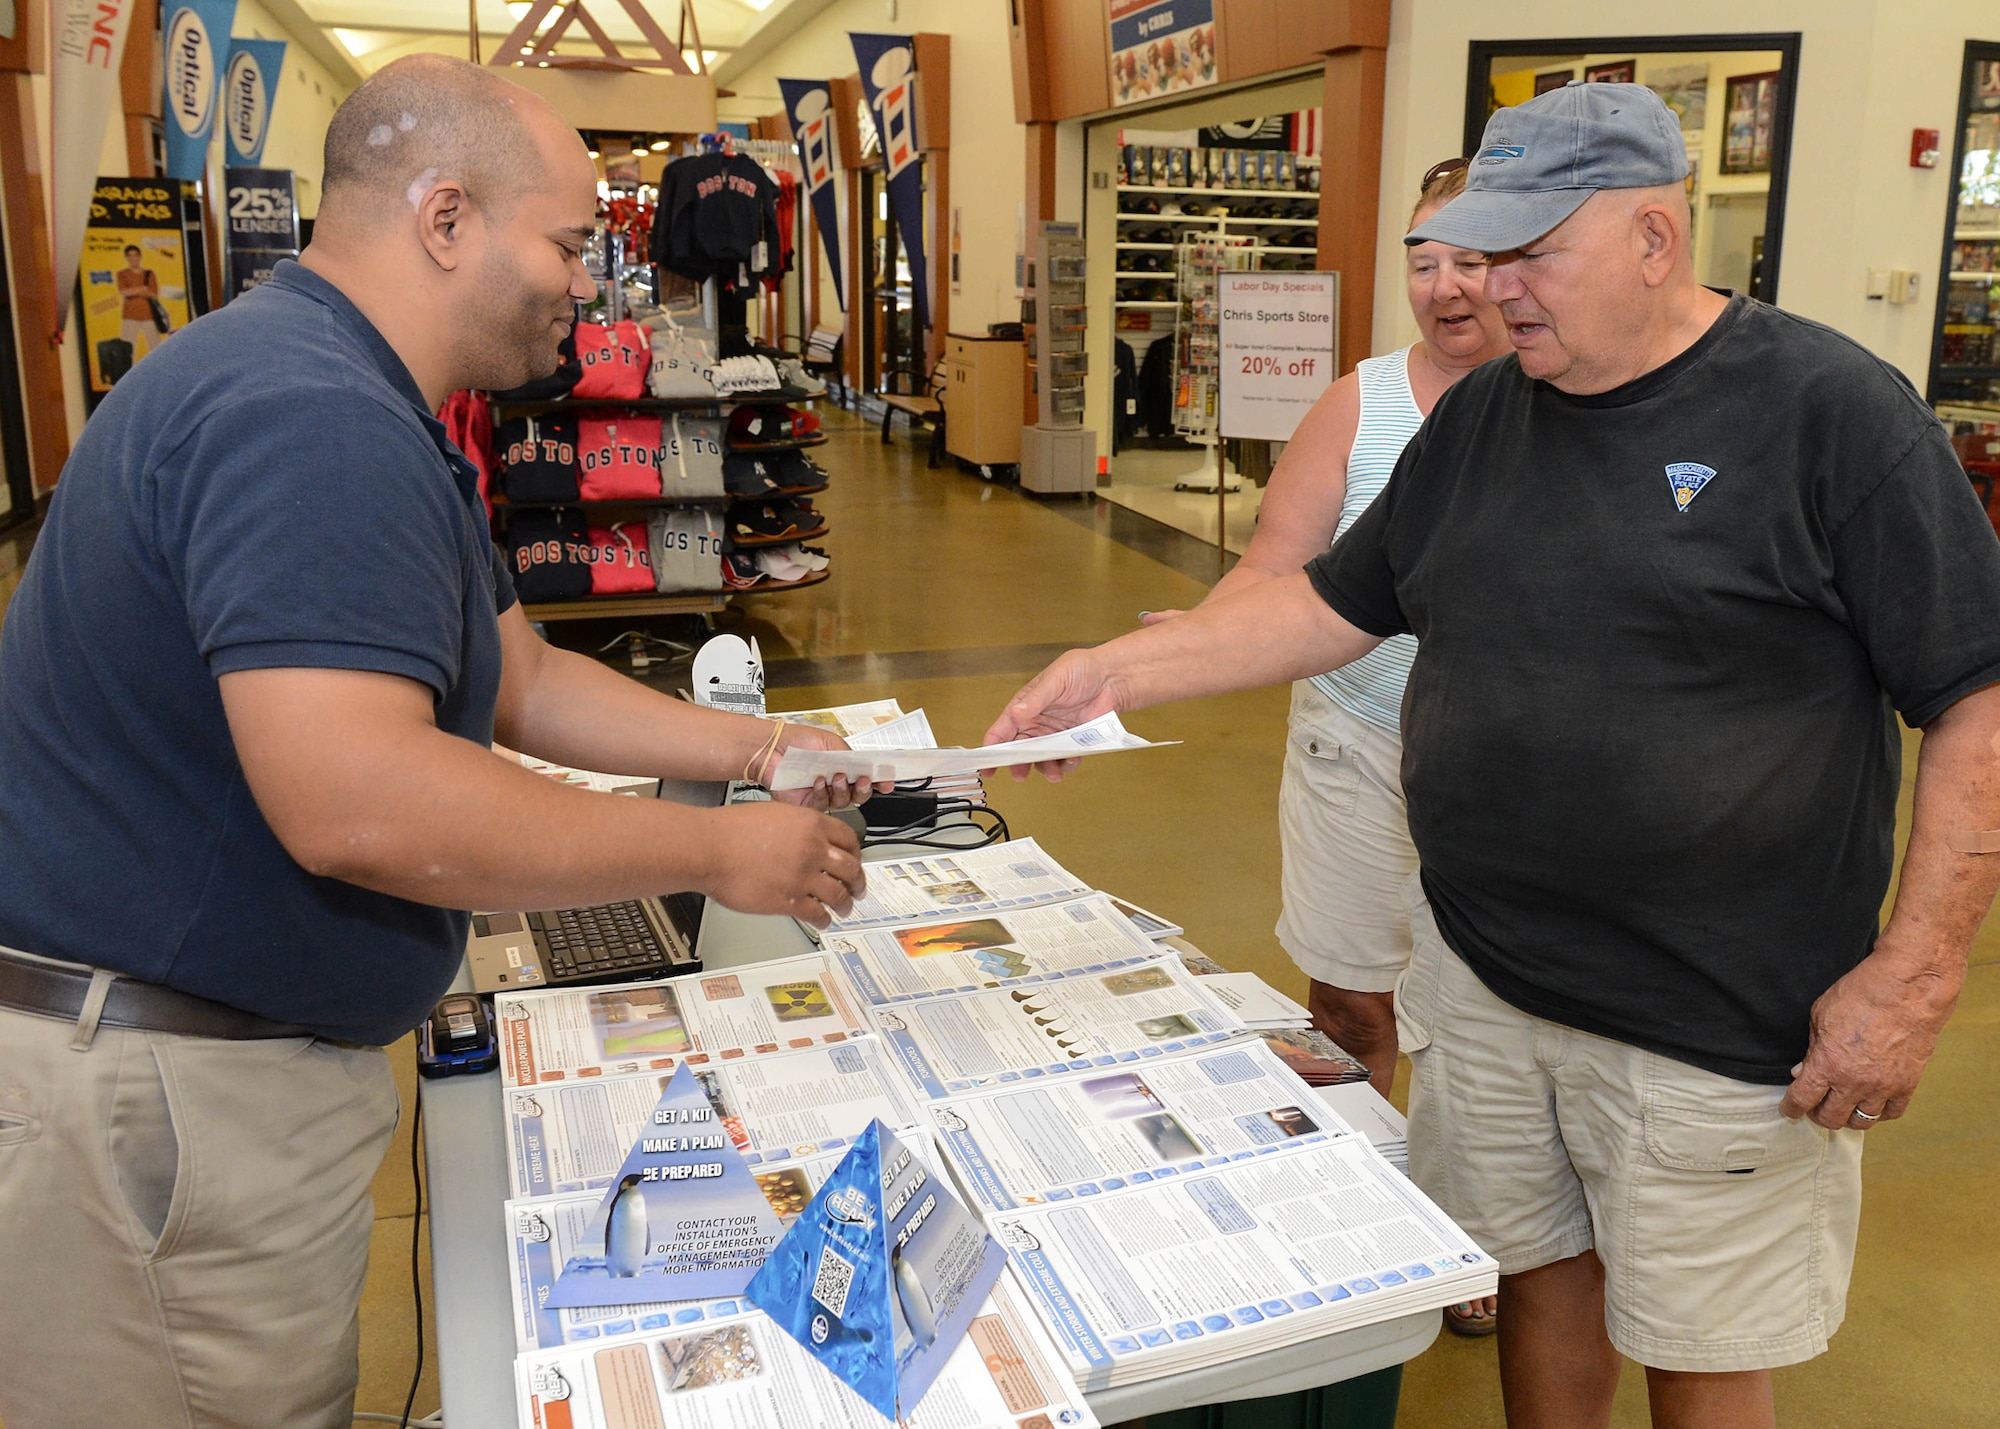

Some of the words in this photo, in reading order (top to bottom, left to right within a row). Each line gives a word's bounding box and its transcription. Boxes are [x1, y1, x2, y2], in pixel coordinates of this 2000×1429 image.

[1148, 11, 1174, 31] CHRIS
[86, 0, 122, 68] NC
[181, 28, 201, 118] Optical
[239, 68, 256, 142] Optical
[697, 174, 757, 199] BOSTON
[118, 203, 172, 220] TAGS
[229, 187, 290, 218] 25%
[233, 219, 291, 233] LENSES
[1232, 282, 1259, 291] Labor
[1262, 282, 1279, 293] Day
[1283, 282, 1324, 292] Specials
[1223, 309, 1253, 320] Chris
[1257, 310, 1294, 323] Sports
[1298, 311, 1329, 322] Store
[1242, 356, 1282, 376] 20%
[1288, 358, 1315, 376] off
[1666, 464, 1714, 478] MASSACHUSETTS
[1675, 474, 1702, 483] STATE
[1674, 481, 1699, 489] POLICE
[515, 1020, 525, 1039] PLANTS
[517, 1040, 528, 1059] POWER
[520, 1060, 531, 1082] NUCLEAR
[905, 1045, 930, 1078] TORNADOES
[655, 1110, 676, 1124] GET
[681, 1109, 689, 1122] A
[692, 1107, 712, 1121] KIT
[528, 1135, 540, 1150] HEAT
[642, 1137, 677, 1153] MAKE
[681, 1137, 689, 1150] A
[692, 1135, 724, 1150] PLAN
[955, 1130, 977, 1156] LIGHTNING
[530, 1152, 544, 1182] EXTREME
[881, 1167, 896, 1189] GET
[892, 1160, 902, 1175] A
[897, 1148, 911, 1168] KIT
[970, 1156, 984, 1166] AND
[643, 1167, 659, 1181] BE
[661, 1163, 723, 1180] PREPARED
[846, 1185, 867, 1207] BE
[886, 1192, 907, 1222] MAKE
[903, 1186, 912, 1200] A
[908, 1167, 926, 1194] PLAN
[677, 1218, 726, 1230] CONTACT
[728, 1216, 757, 1226] YOUR
[832, 1195, 877, 1232] READY
[905, 1193, 936, 1236] PREPARED
[675, 1226, 758, 1241] INSTALLATION'S
[657, 1242, 693, 1254] OFFICE
[697, 1241, 711, 1251] OF
[713, 1235, 776, 1250] EMERGENCY
[667, 1250, 742, 1263] MANAGEMENT
[744, 1248, 765, 1258] FOR
[933, 1239, 956, 1273] CONTACT
[1028, 1251, 1045, 1268] COLD
[663, 1265, 693, 1275] MORE
[934, 1276, 952, 1303] OFFICE
[949, 1267, 957, 1280] OF
[956, 1232, 979, 1271] EMERGENCY
[1037, 1268, 1062, 1295] EXTREME
[1055, 1294, 1070, 1308] AND
[1063, 1309, 1087, 1335] STORMS
[1079, 1335, 1102, 1360] WINTER
